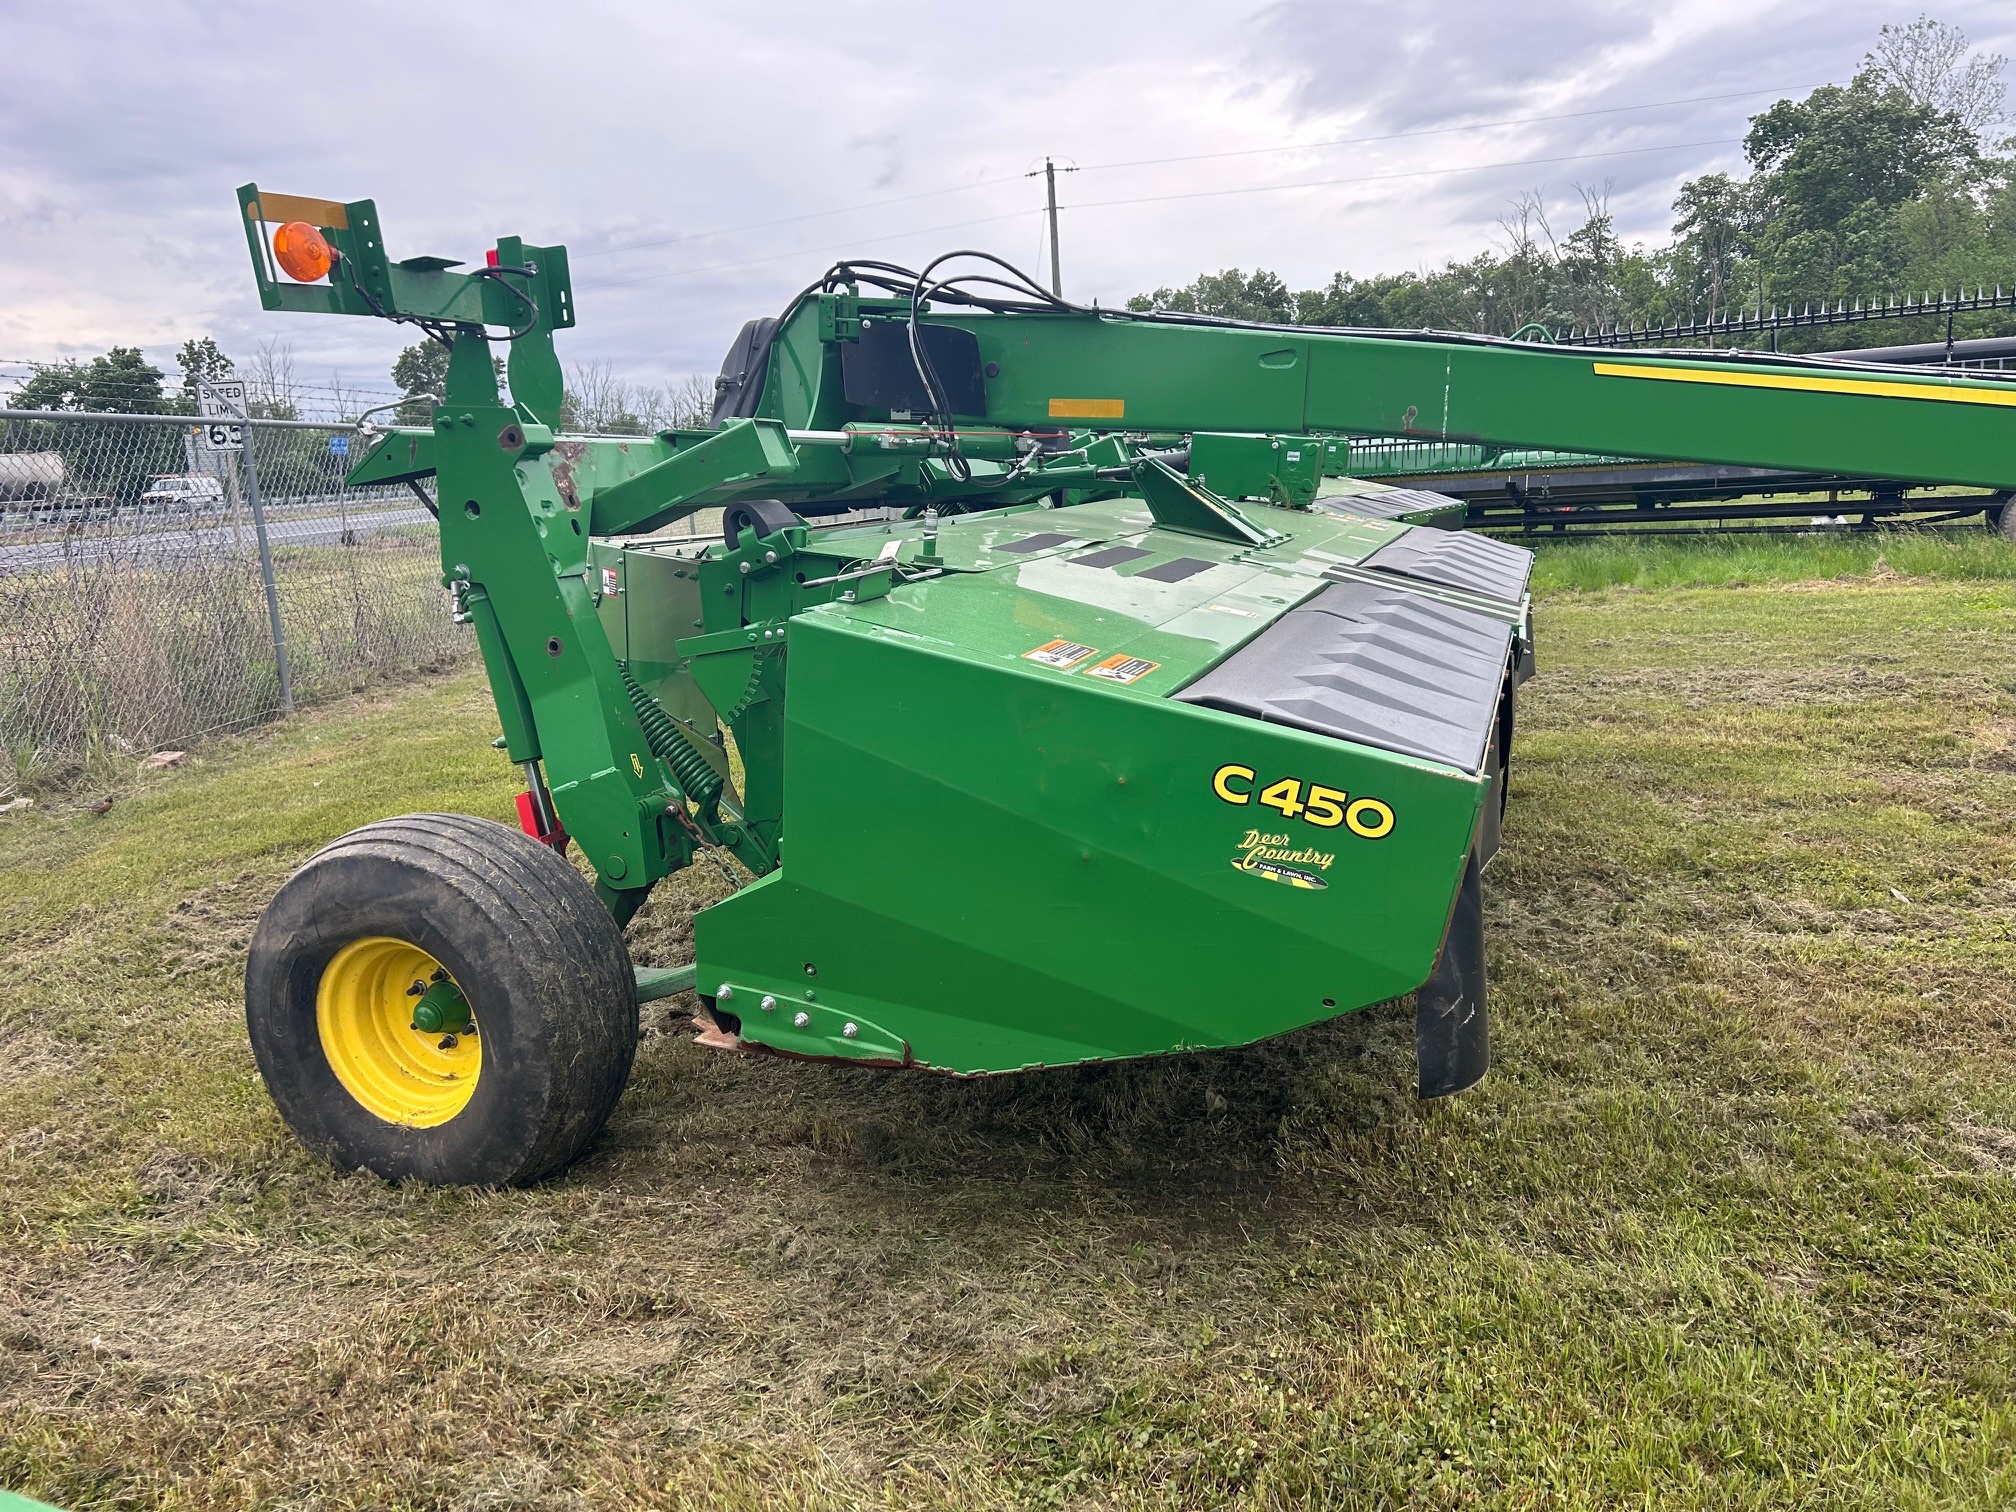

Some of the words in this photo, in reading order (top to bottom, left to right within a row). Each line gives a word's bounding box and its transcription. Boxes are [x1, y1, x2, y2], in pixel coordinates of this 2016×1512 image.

[1211, 762, 1257, 807] C
[1257, 776, 1397, 840] 450
[1235, 828, 1290, 850] Deer
[1241, 845, 1335, 871] Country
[1259, 863, 1276, 873] FARM
